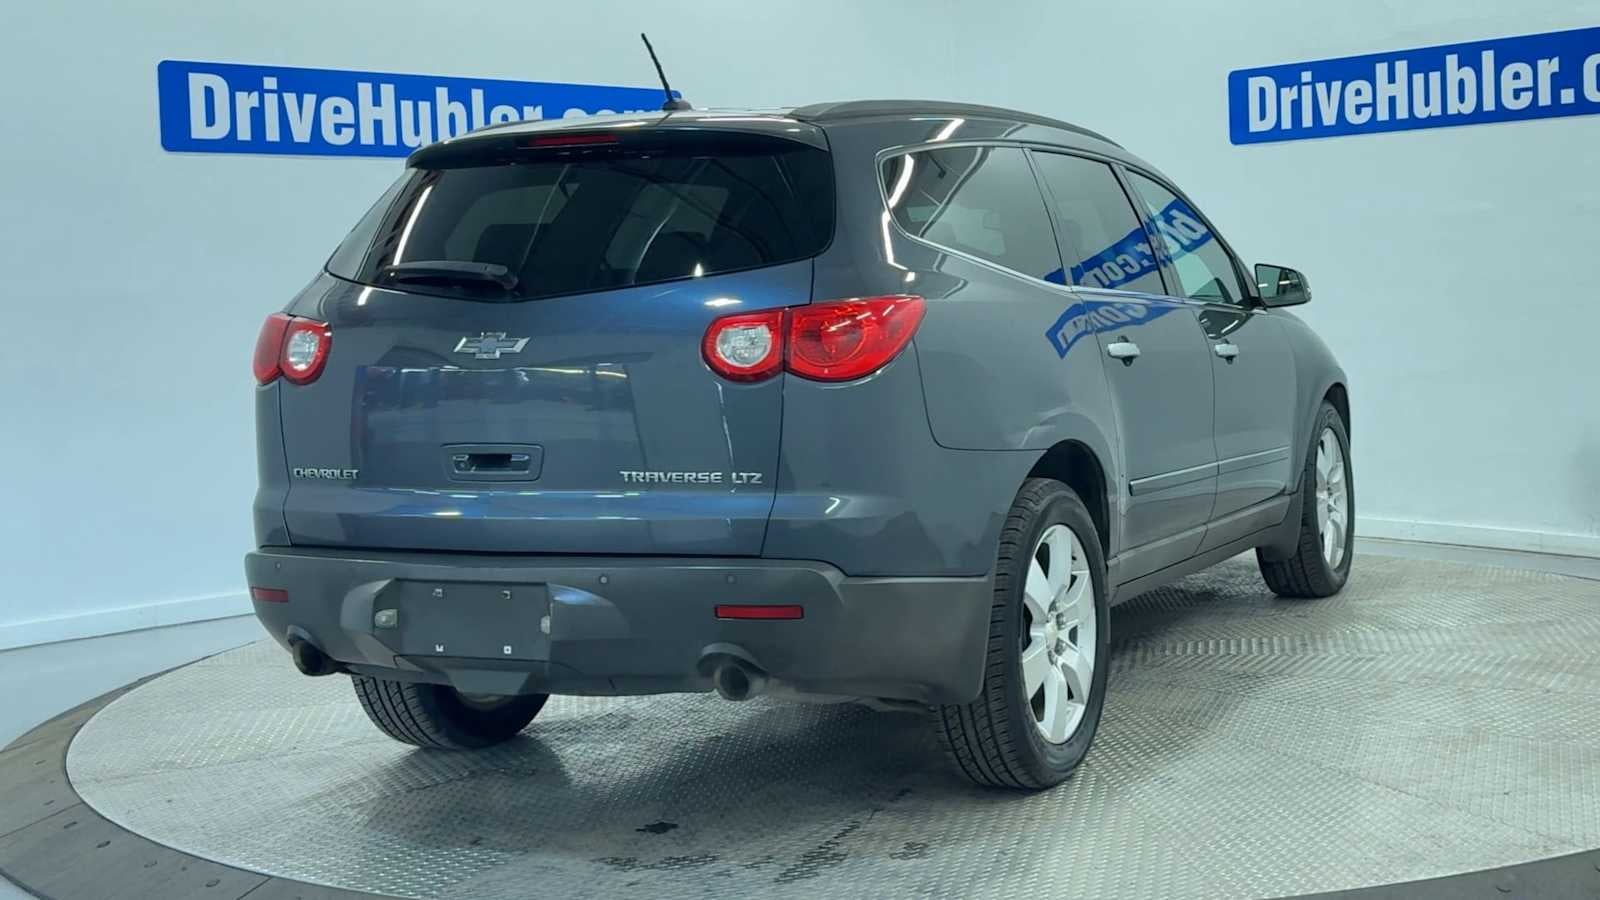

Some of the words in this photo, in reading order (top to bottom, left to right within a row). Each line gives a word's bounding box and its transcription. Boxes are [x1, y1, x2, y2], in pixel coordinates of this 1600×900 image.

[293, 468, 359, 480] CHEVROLET
[619, 471, 722, 484] TRAVERSE
[732, 472, 763, 484] LTZ
